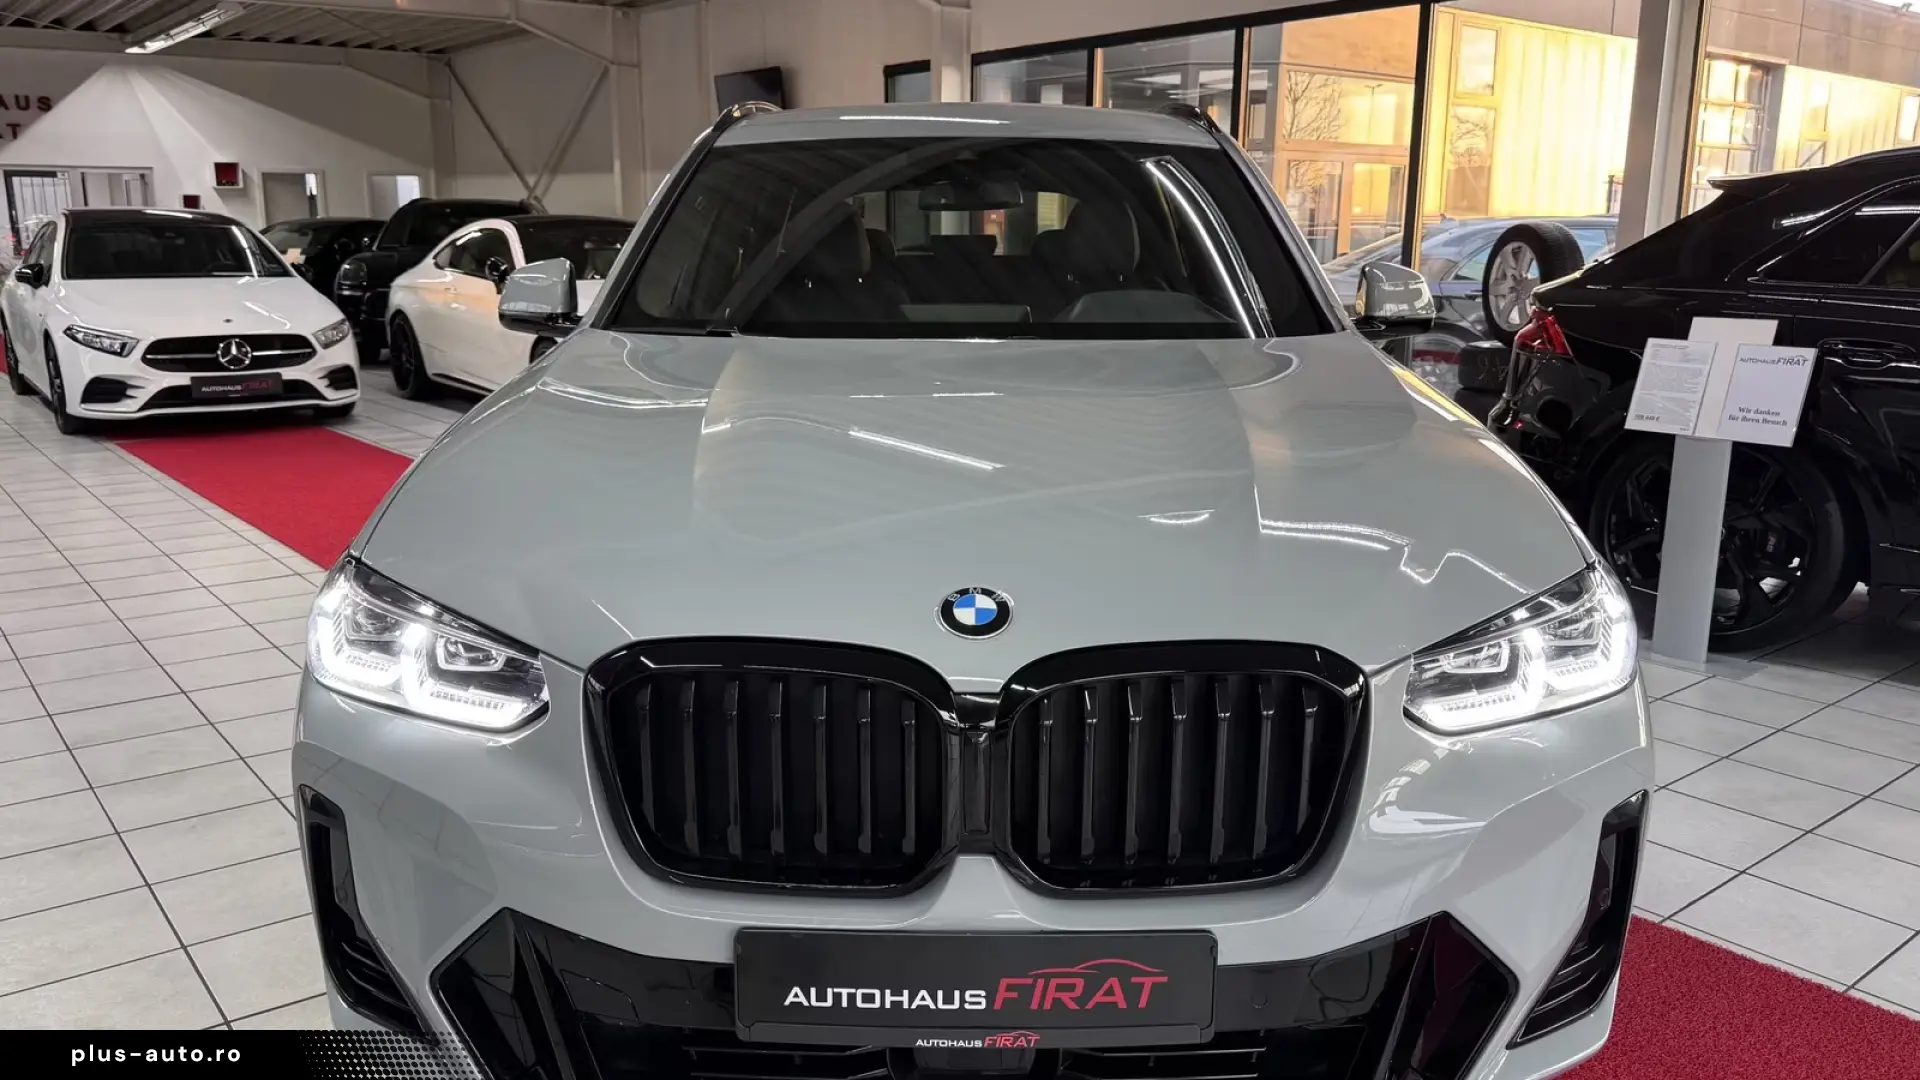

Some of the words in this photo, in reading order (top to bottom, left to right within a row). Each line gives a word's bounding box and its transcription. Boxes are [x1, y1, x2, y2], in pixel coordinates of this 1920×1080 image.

[0, 123, 22, 140] T
[1775, 357, 1807, 367] FIRAT
[1738, 406, 1753, 414] Wir
[1753, 407, 1781, 417] danken
[1761, 417, 1788, 427] Besuch
[783, 986, 987, 1011] AUTOHAUS
[993, 976, 1169, 1011] FIRAT
[915, 1038, 983, 1048] AUTOHAUS
[983, 1035, 1041, 1048] FIRAT
